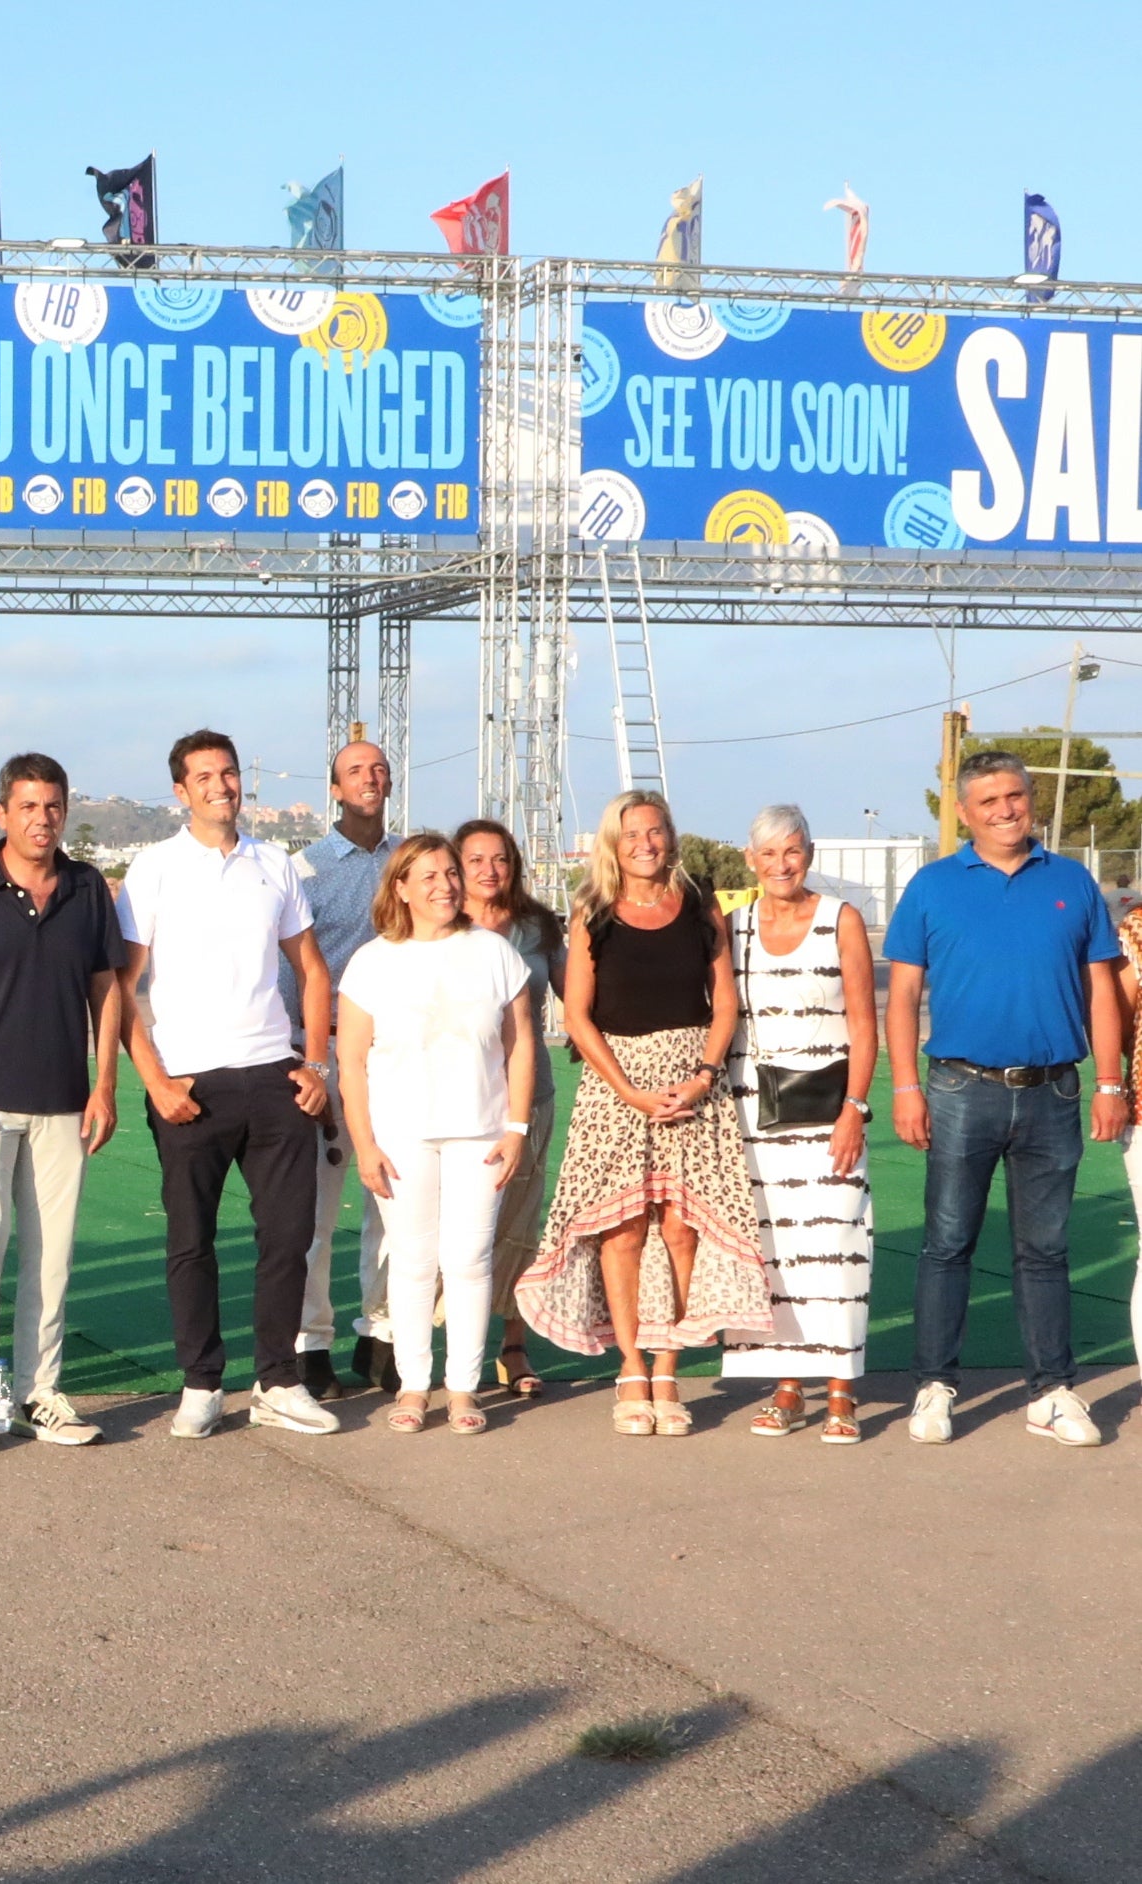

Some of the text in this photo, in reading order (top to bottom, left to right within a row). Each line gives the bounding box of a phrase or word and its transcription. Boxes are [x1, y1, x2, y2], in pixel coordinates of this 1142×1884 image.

[41, 284, 80, 329] FIB
[30, 338, 177, 467] ONCE
[191, 345, 466, 470] BELONGED
[623, 374, 911, 477] SEE YOU SOON!
[73, 477, 106, 514] FIB
[165, 478, 198, 516] FIB
[256, 480, 290, 517] FIB
[346, 482, 379, 519] FIB
[435, 483, 469, 520] FIB
[579, 490, 624, 540] FIB
[903, 503, 948, 549] FIB
